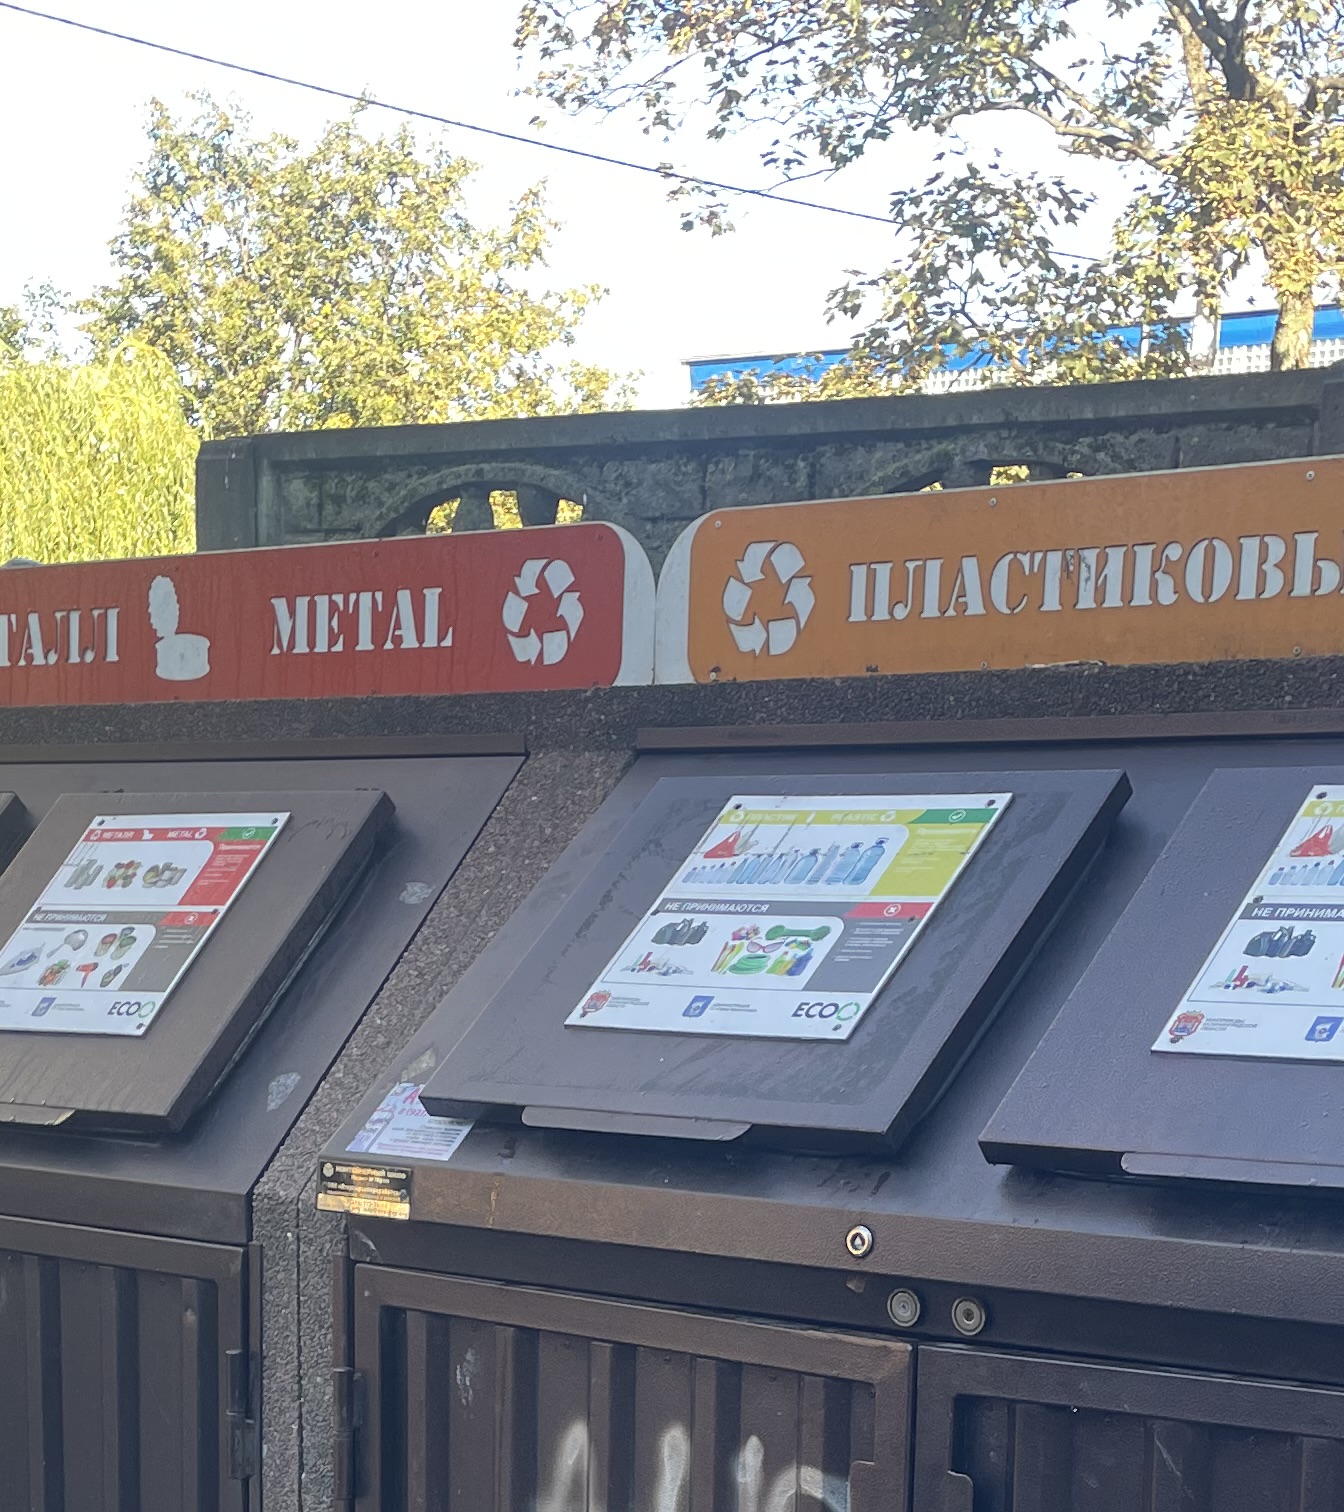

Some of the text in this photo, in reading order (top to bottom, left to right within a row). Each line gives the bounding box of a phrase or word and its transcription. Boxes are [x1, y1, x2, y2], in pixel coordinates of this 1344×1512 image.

[270, 587, 453, 656] METAL
[664, 902, 769, 914] НЕ ПРИНИМАЮТСЯ
[1251, 907, 1272, 919] НЕ
